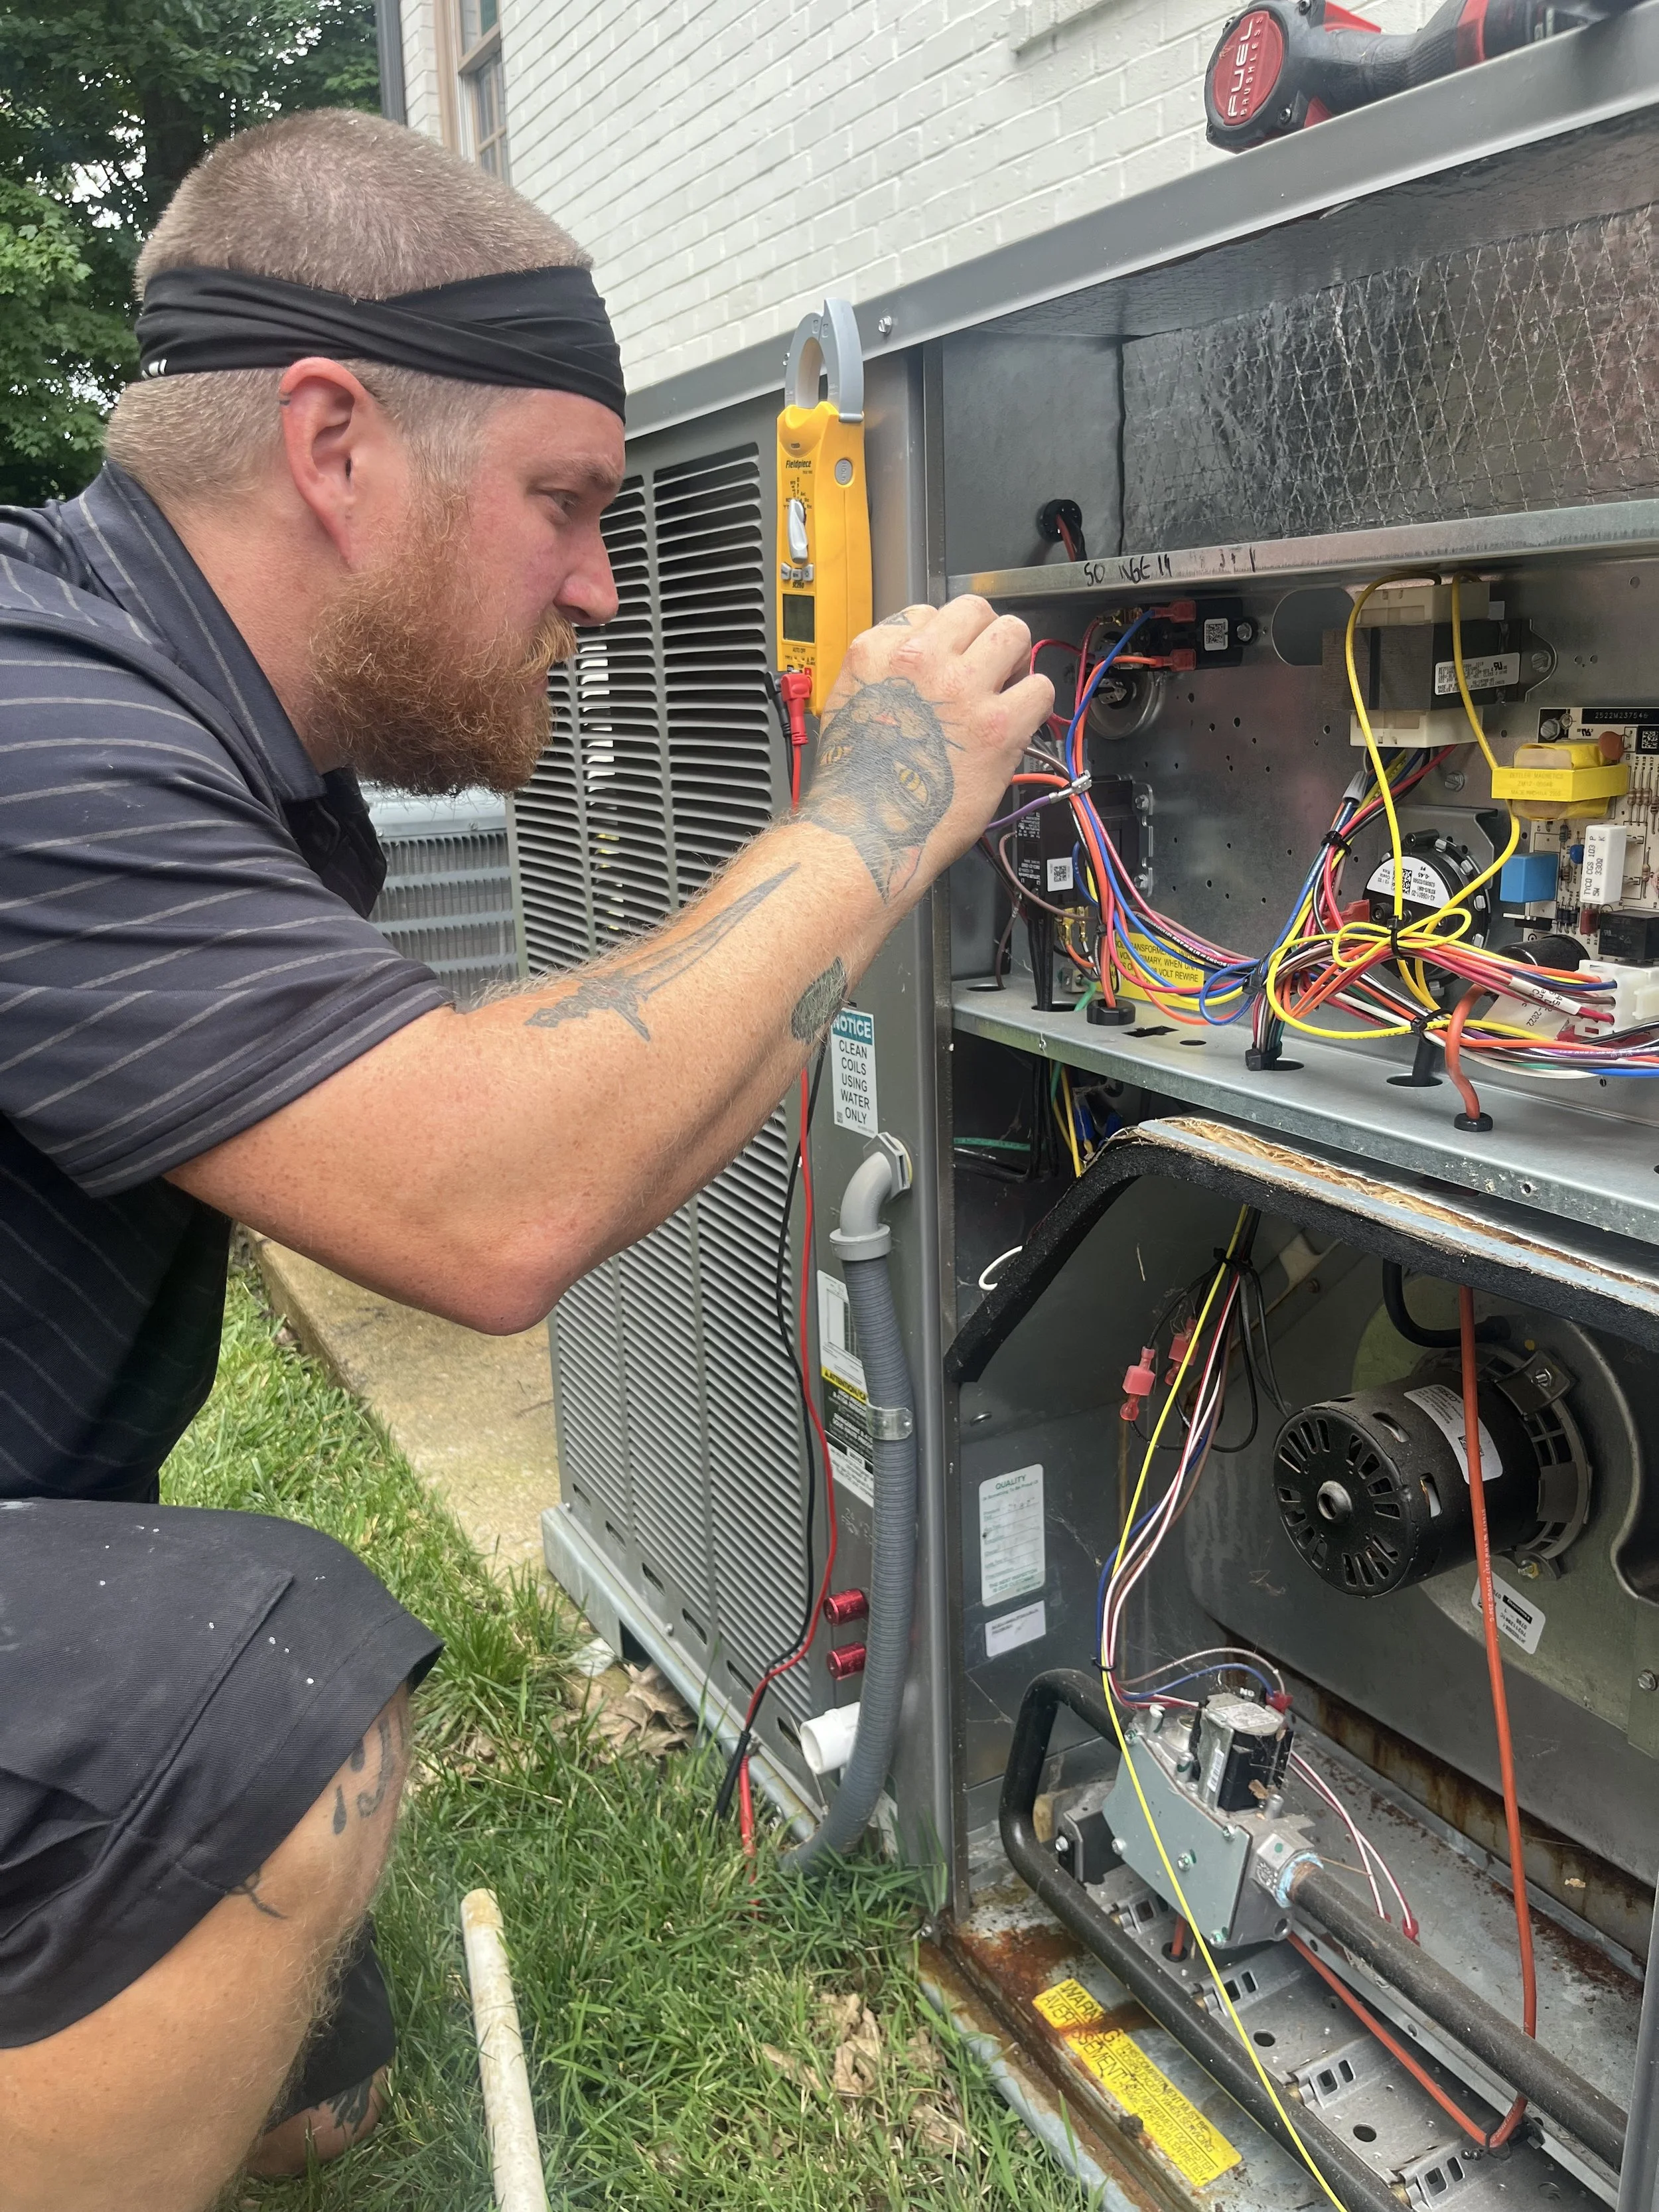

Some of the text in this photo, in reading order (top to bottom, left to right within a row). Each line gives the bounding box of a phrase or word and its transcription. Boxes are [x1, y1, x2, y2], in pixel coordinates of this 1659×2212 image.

[1228, 19, 1254, 117] FUEL
[1240, 17, 1263, 115] BRUSHLESS
[786, 460, 812, 469] Fieldpiece
[1584, 878, 1593, 895] TYCO
[1592, 888, 1600, 897] 5W
[1165, 958, 1183, 969] WHEN
[1159, 968, 1198, 982] VOLT REWIRE
[833, 1015, 871, 1039] NOTICE
[839, 1040, 867, 1059] CLEAN
[841, 1057, 867, 1075] COILS
[842, 1072, 867, 1092] USING
[841, 1088, 871, 1110] WATER
[845, 1106, 867, 1125] ONLY
[995, 1475, 1027, 1491] QUALITY
[1240, 1687, 1255, 1697] NO
[1058, 1978, 1124, 2047] WARNG:
[1135, 2054, 1183, 2104] COMPARTMENT
[1179, 2101, 1200, 2123] MUST
[1039, 1990, 1129, 2085] AVERTSSEMENT:
[1188, 2146, 1215, 2174] RESTER
[1151, 2120, 1173, 2142] POUR
[1161, 2096, 1181, 2117] WHEN
[1179, 2116, 1214, 2153] SERVICING
